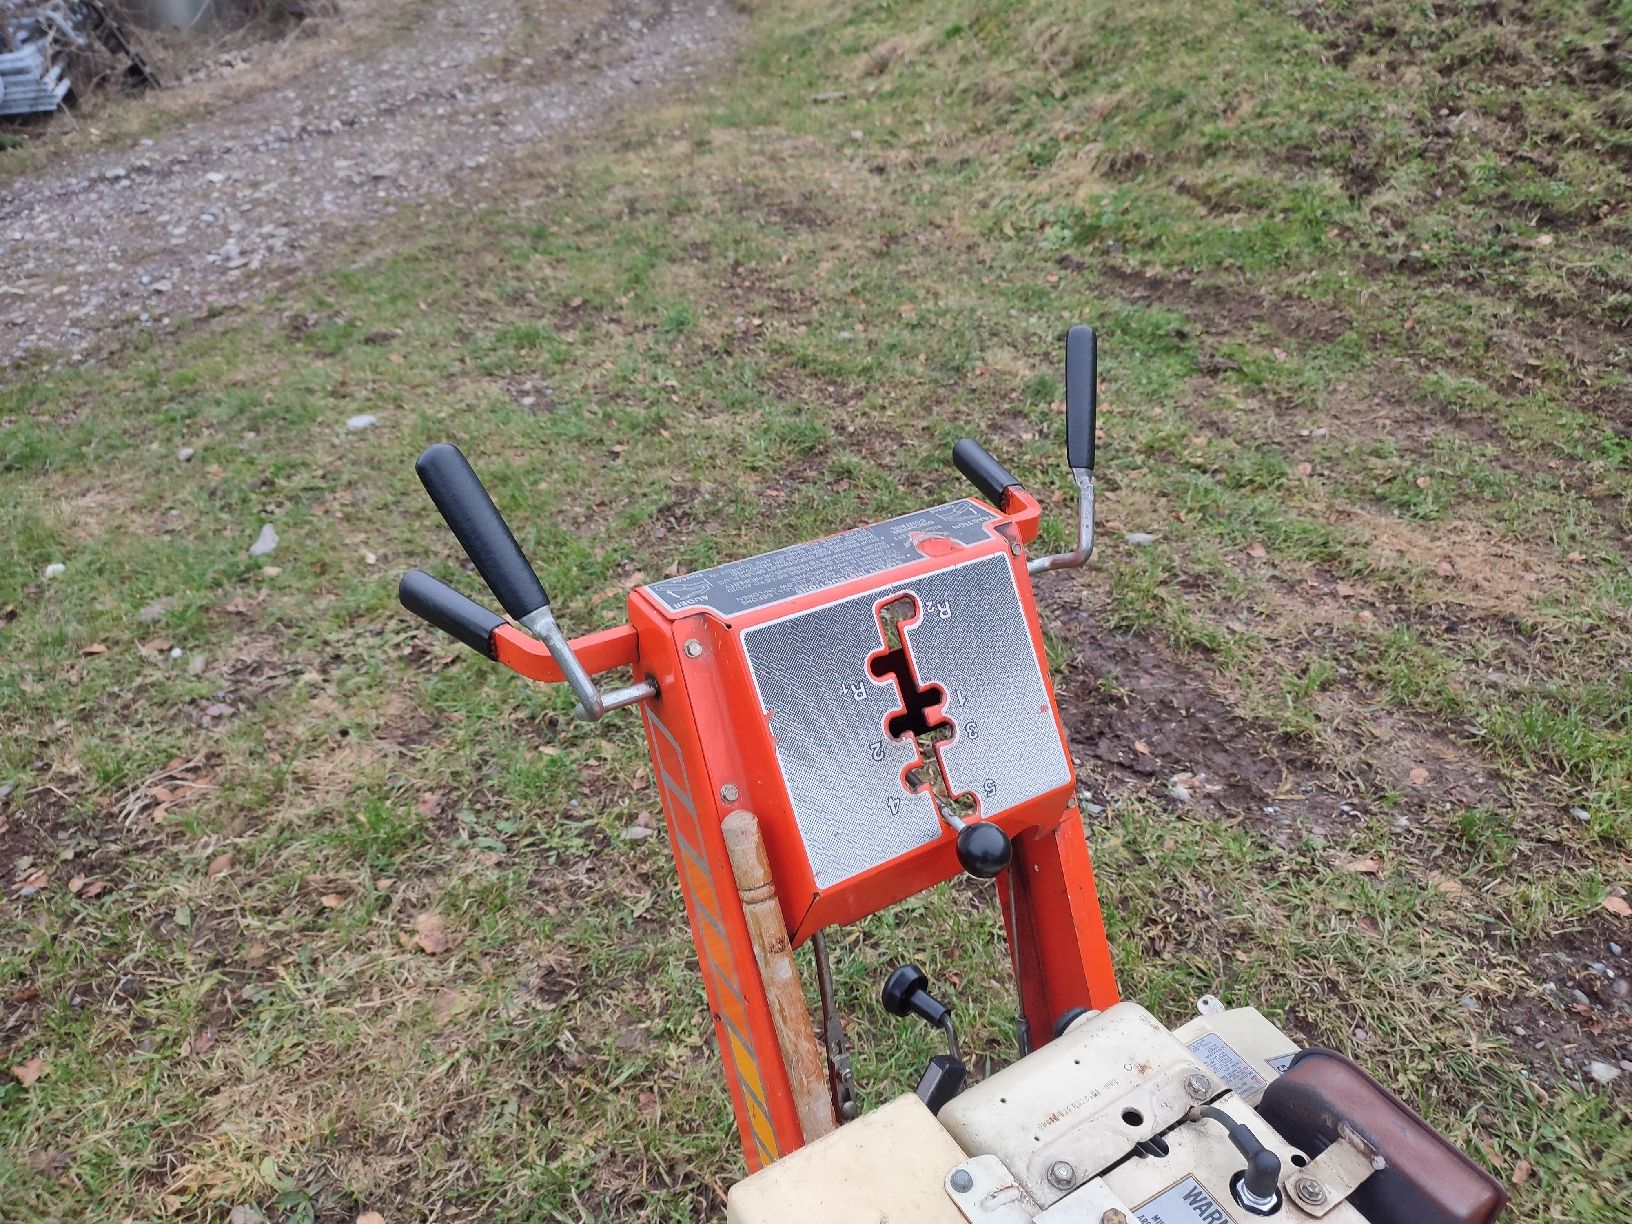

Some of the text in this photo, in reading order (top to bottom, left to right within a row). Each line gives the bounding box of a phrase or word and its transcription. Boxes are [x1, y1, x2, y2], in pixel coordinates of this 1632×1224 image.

[951, 514, 994, 530] TRACTION
[672, 594, 710, 609] AUGER
[965, 722, 979, 740] 3
[869, 741, 885, 761] 2
[983, 778, 997, 798] 5
[887, 796, 900, 815] 4
